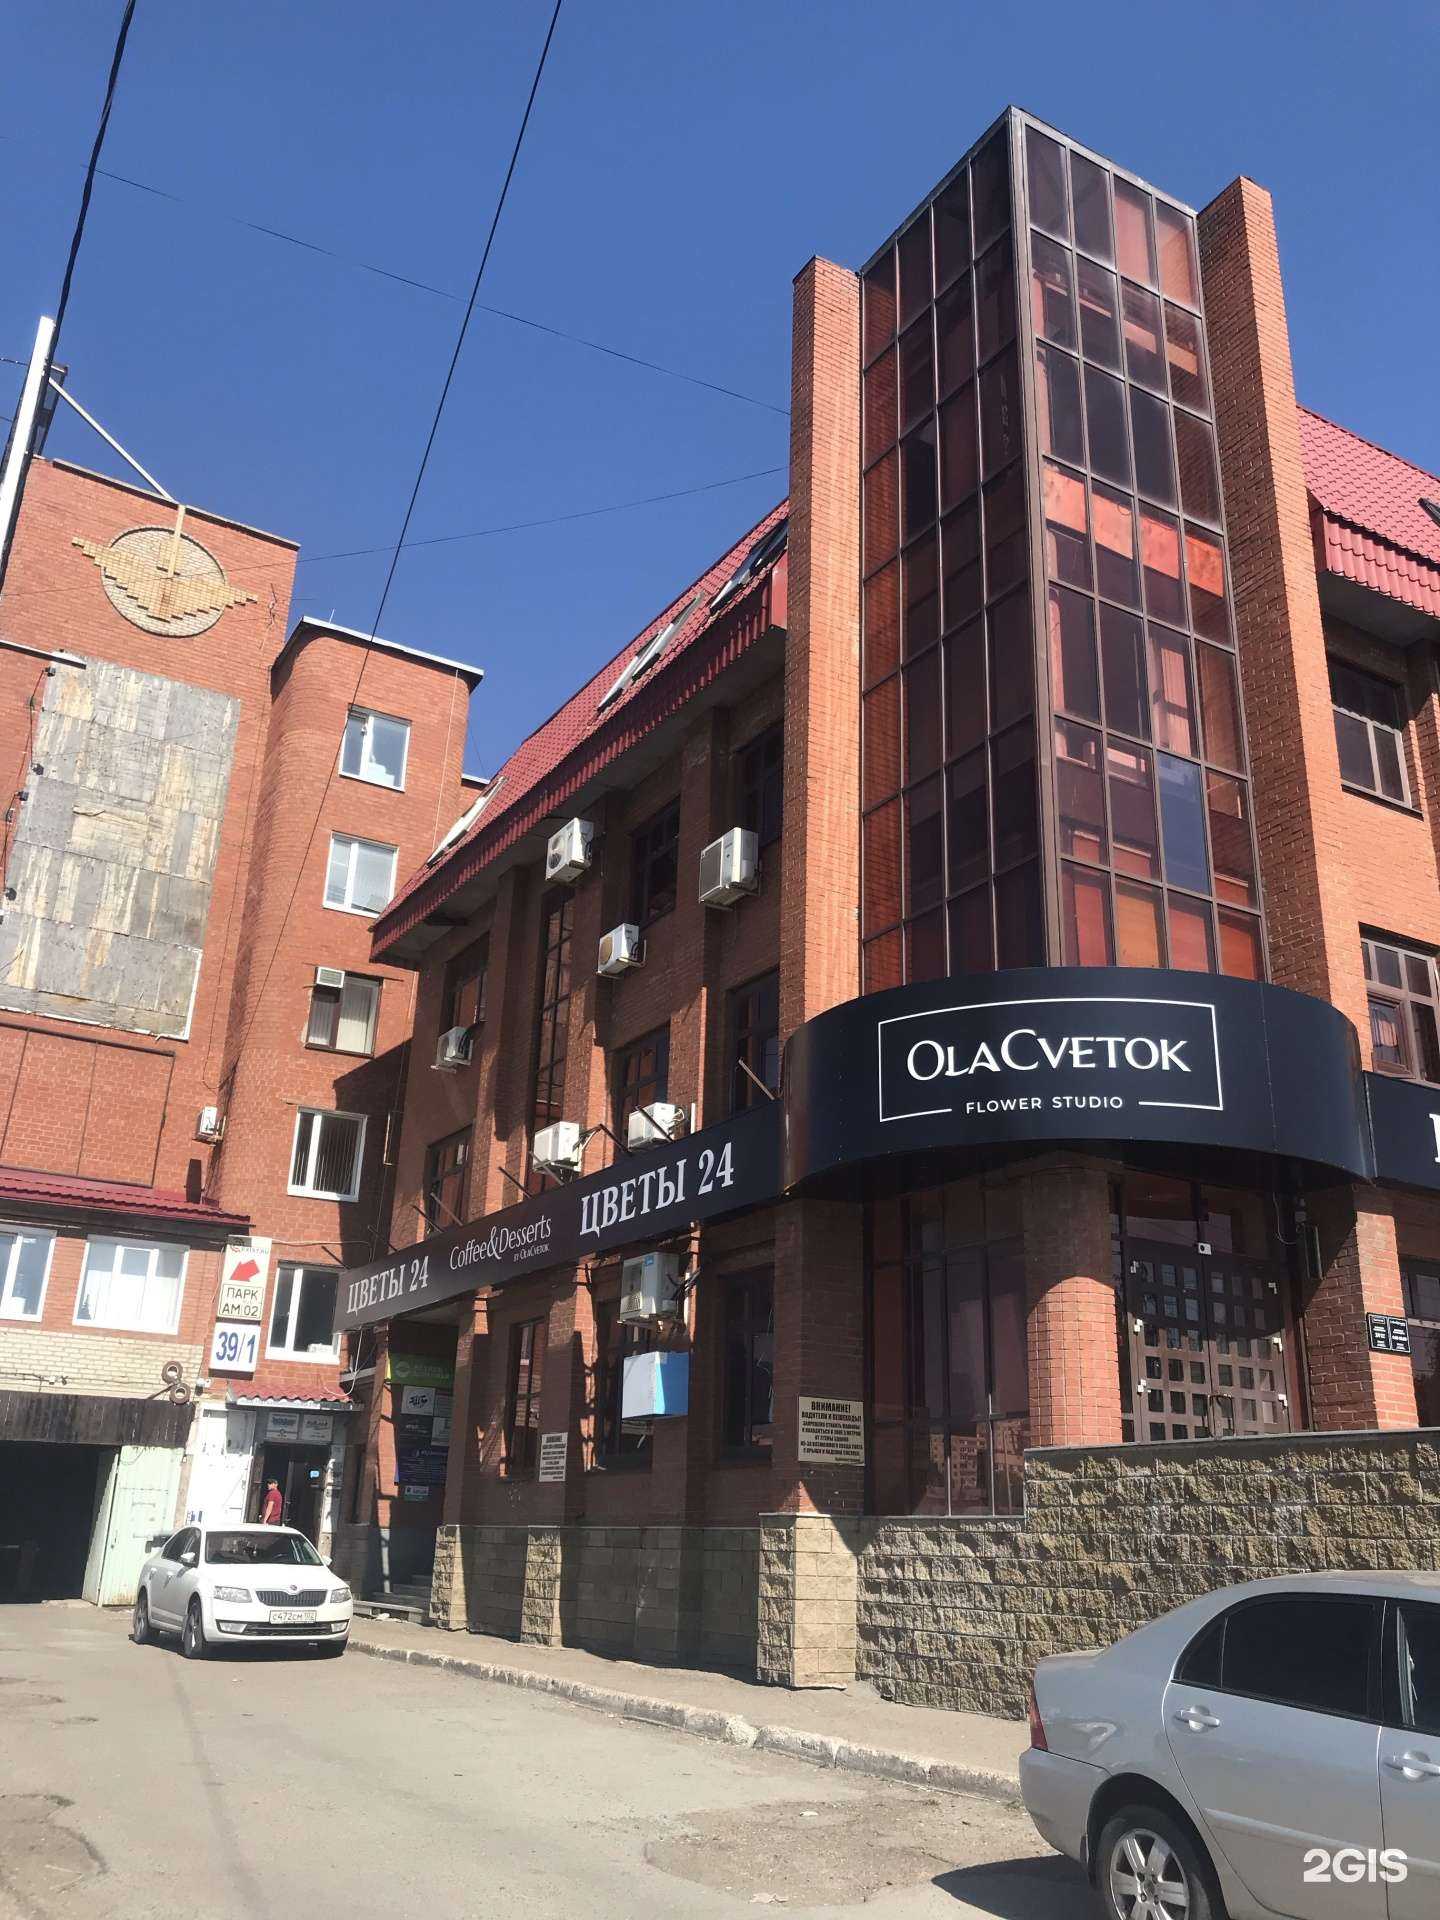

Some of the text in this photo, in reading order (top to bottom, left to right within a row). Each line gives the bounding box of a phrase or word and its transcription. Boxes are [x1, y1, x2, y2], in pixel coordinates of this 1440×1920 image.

[965, 1096, 1123, 1115] FLOWER STUDIO
[579, 1141, 735, 1239] ЦВЕТЫ 24
[227, 1287, 259, 1301] ПАРК
[346, 1255, 430, 1317] ЦВЕТЫ 24
[243, 1305, 259, 1317] 02
[215, 1331, 256, 1364] 39/1
